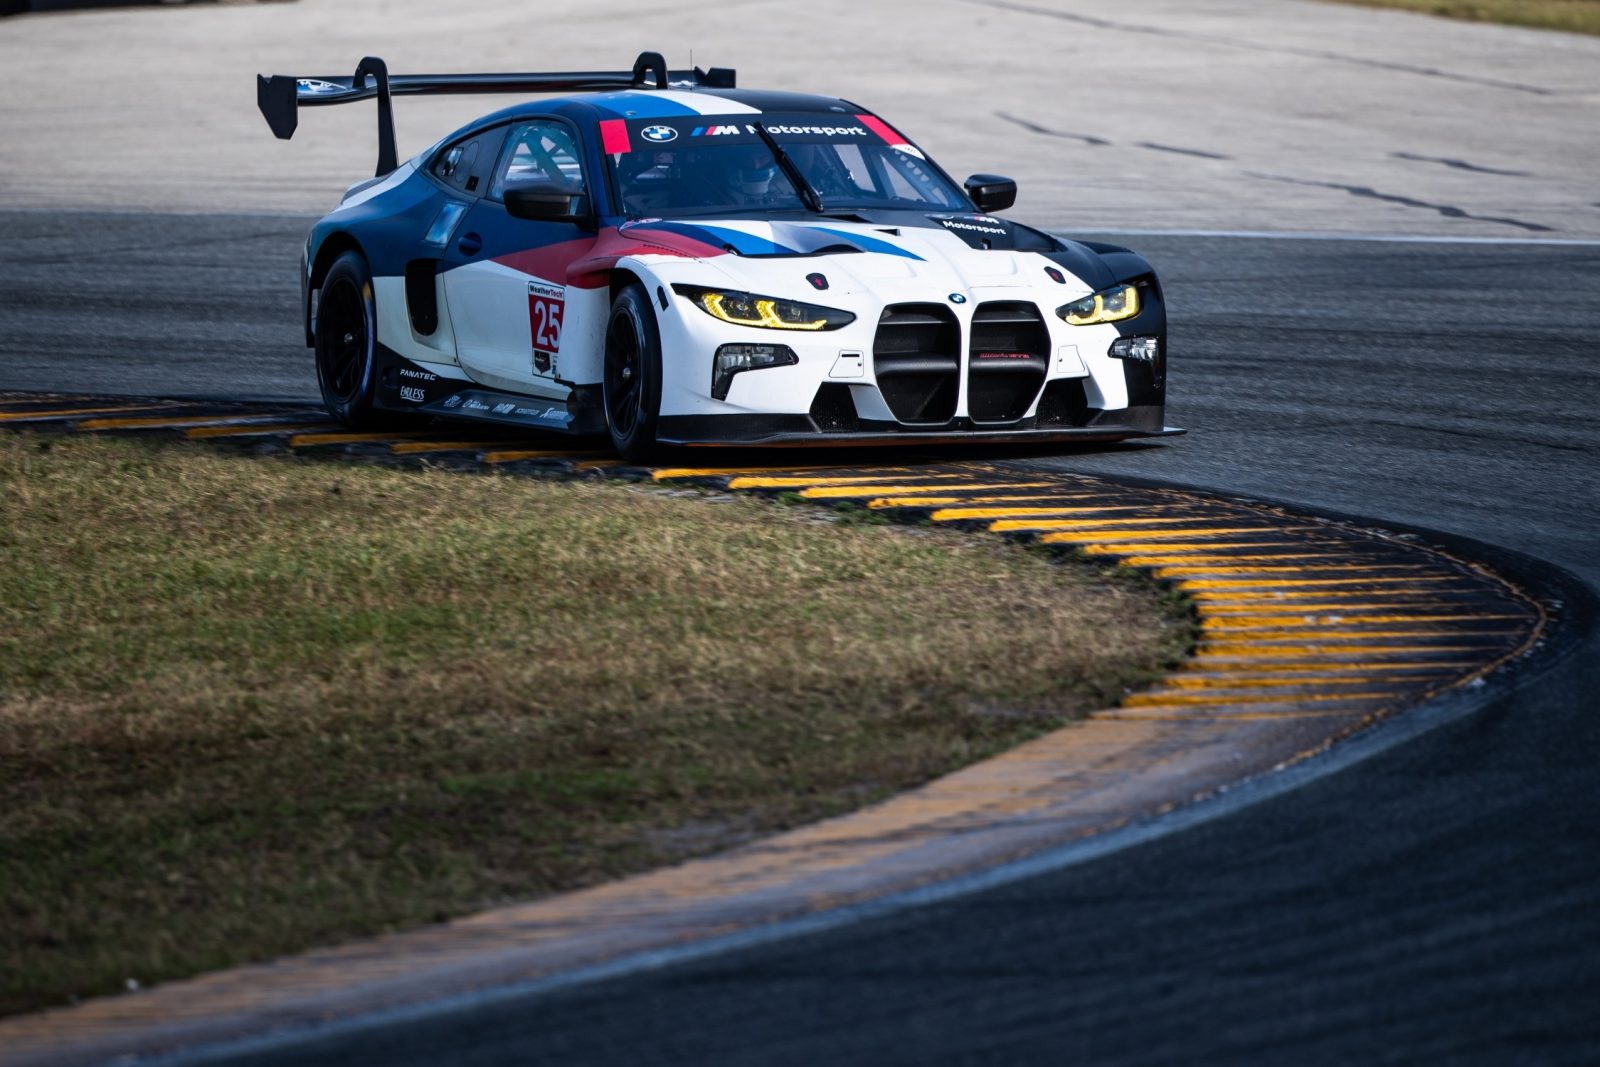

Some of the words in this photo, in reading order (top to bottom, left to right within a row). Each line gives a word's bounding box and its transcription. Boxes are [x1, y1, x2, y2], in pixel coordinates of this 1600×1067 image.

[942, 221, 1007, 234] Motorsport
[529, 284, 563, 298] WeatherTech
[535, 300, 561, 349] 25
[400, 368, 437, 381] FANATEC
